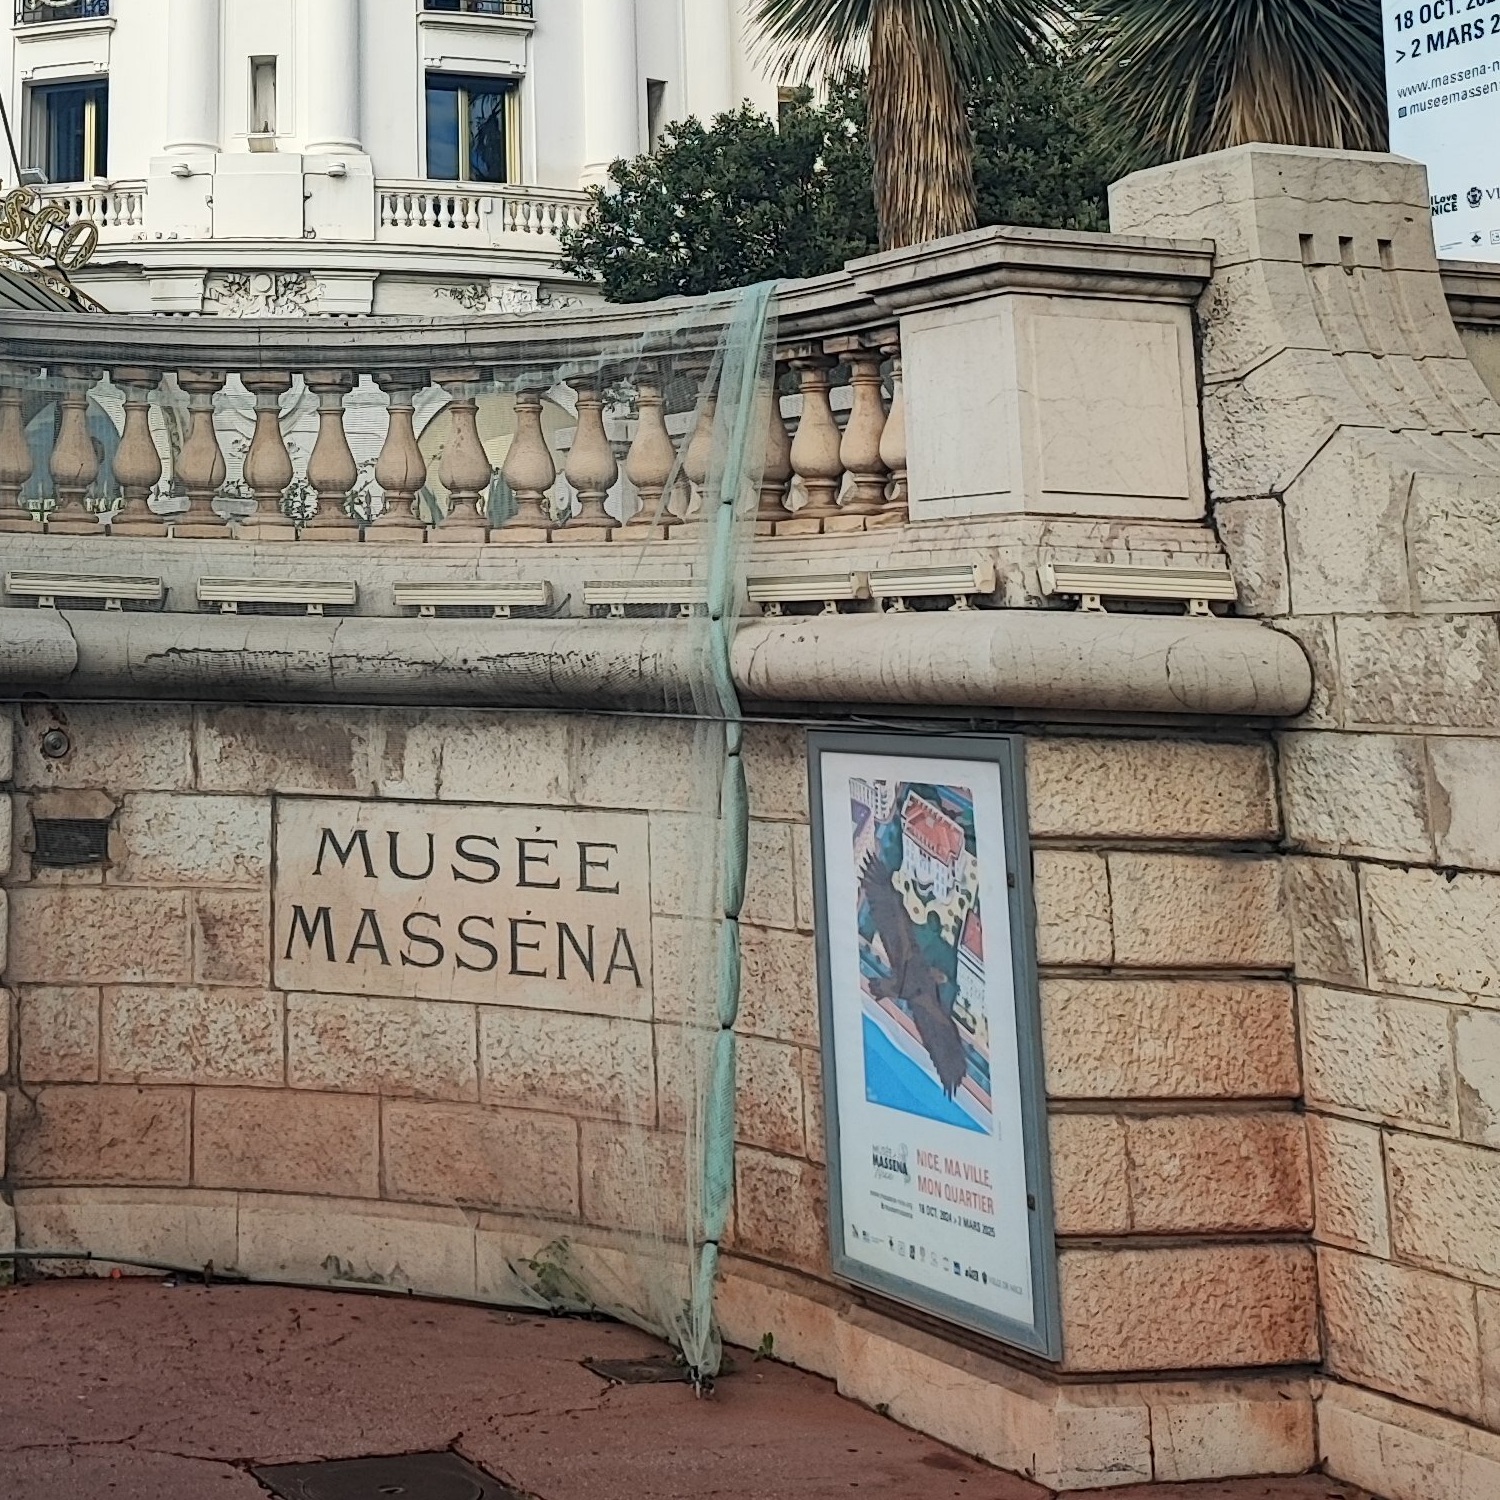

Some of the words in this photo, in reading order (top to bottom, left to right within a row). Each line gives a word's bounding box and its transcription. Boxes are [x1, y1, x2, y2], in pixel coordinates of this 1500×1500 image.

[1394, 10, 1414, 32] 18
[1411, 38, 1421, 58] 2
[1426, 18, 1485, 54] MARS
[1409, 80, 1500, 115] museemassen
[1431, 201, 1458, 216] NICE
[311, 826, 621, 894] MUSÉE
[284, 904, 644, 989] MASSÉNA
[916, 1149, 942, 1174] NICE,
[944, 1157, 961, 1178] MA
[963, 1162, 993, 1190] VILLE,
[917, 1175, 942, 1198] MON
[944, 1183, 995, 1215] QUARTIER
[963, 1218, 981, 1232] MARS
